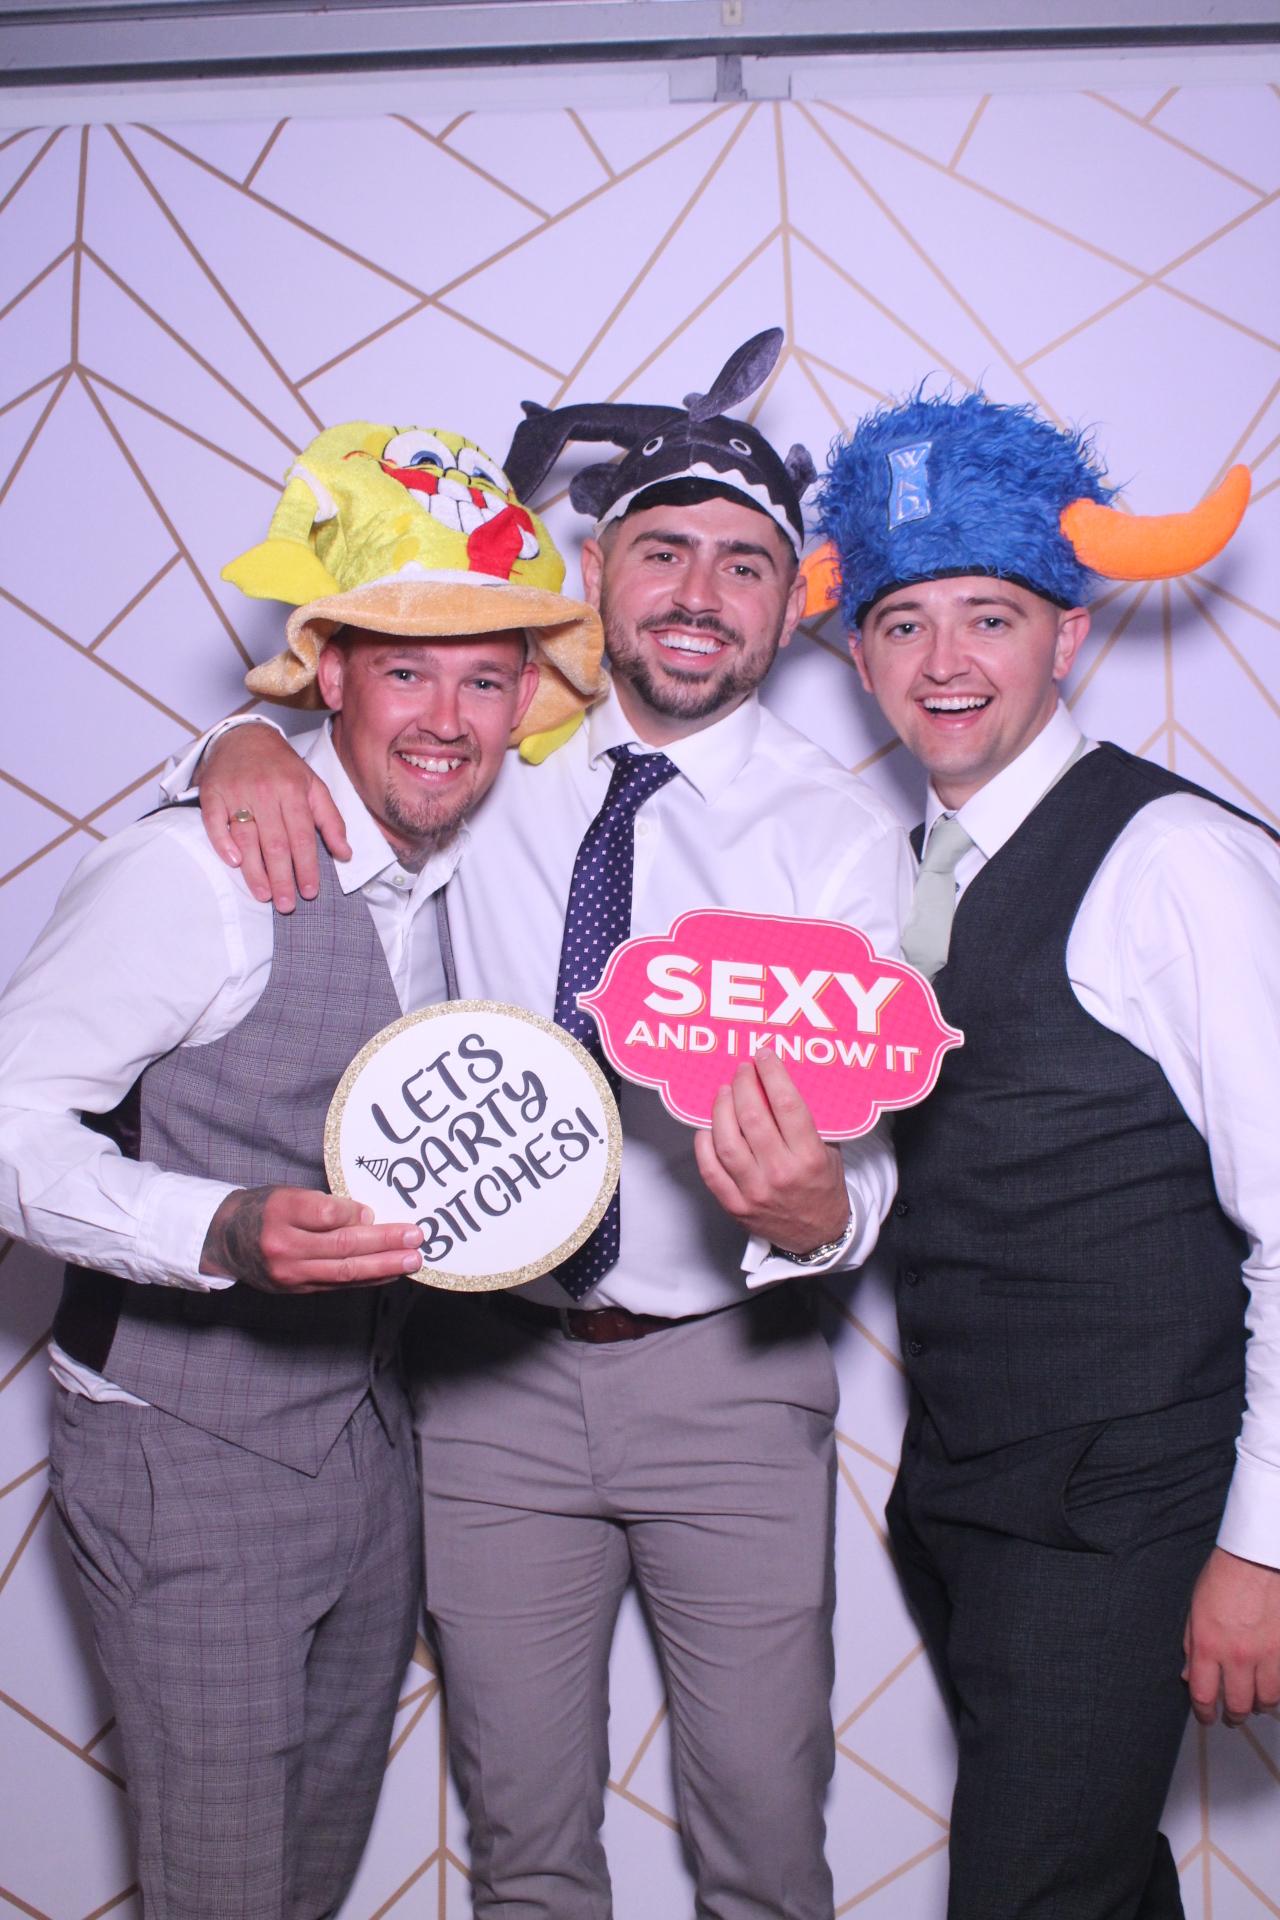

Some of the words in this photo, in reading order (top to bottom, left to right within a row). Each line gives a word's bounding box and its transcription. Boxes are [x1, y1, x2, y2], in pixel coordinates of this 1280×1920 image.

[624, 1020, 717, 1053] AND
[727, 1029, 738, 1056] I
[749, 1032, 878, 1069] KNOW
[886, 1045, 921, 1072] IT
[643, 955, 903, 1035] SEXY
[371, 1034, 504, 1145] LETS
[387, 1071, 549, 1209] PARTY
[416, 1108, 605, 1262] BITCHES!
